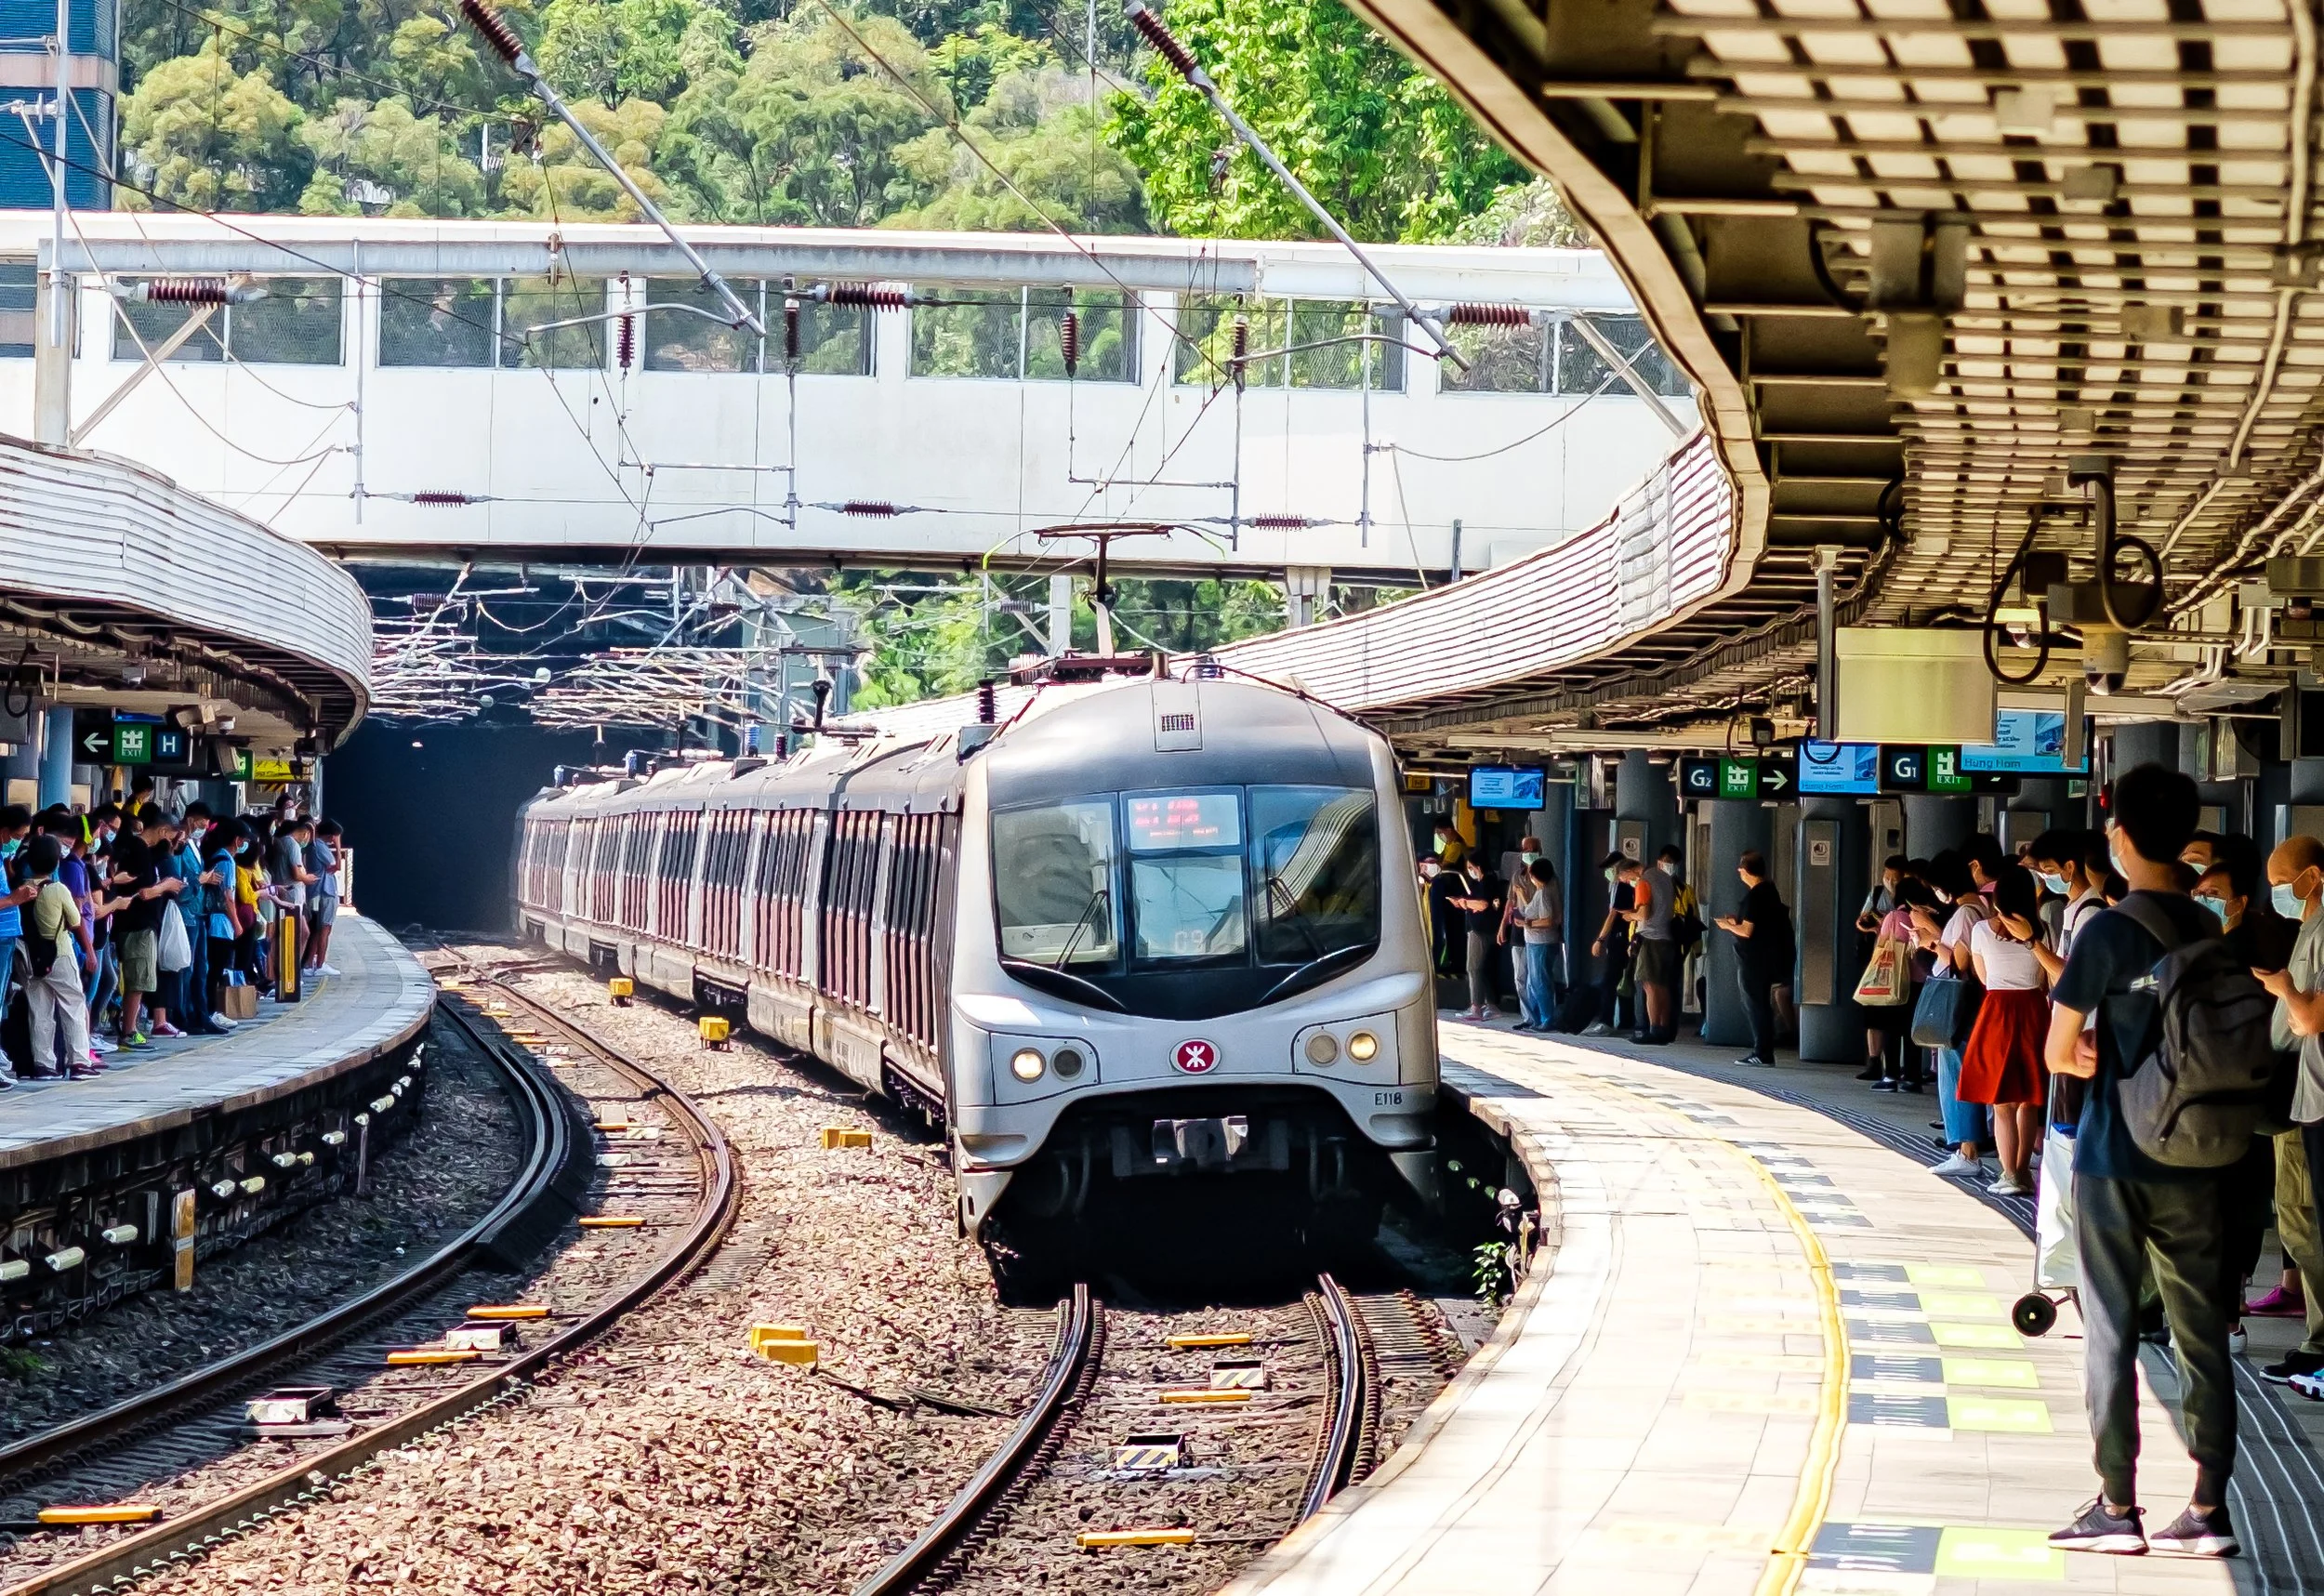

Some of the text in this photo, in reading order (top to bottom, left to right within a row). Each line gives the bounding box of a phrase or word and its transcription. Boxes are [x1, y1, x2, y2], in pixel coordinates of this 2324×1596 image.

[163, 735, 176, 753] H
[122, 748, 142, 758] EXIT
[1964, 758, 2021, 768] Hung Hom
[1937, 775, 1963, 784] EXIT
[1375, 1092, 1403, 1106] E118
